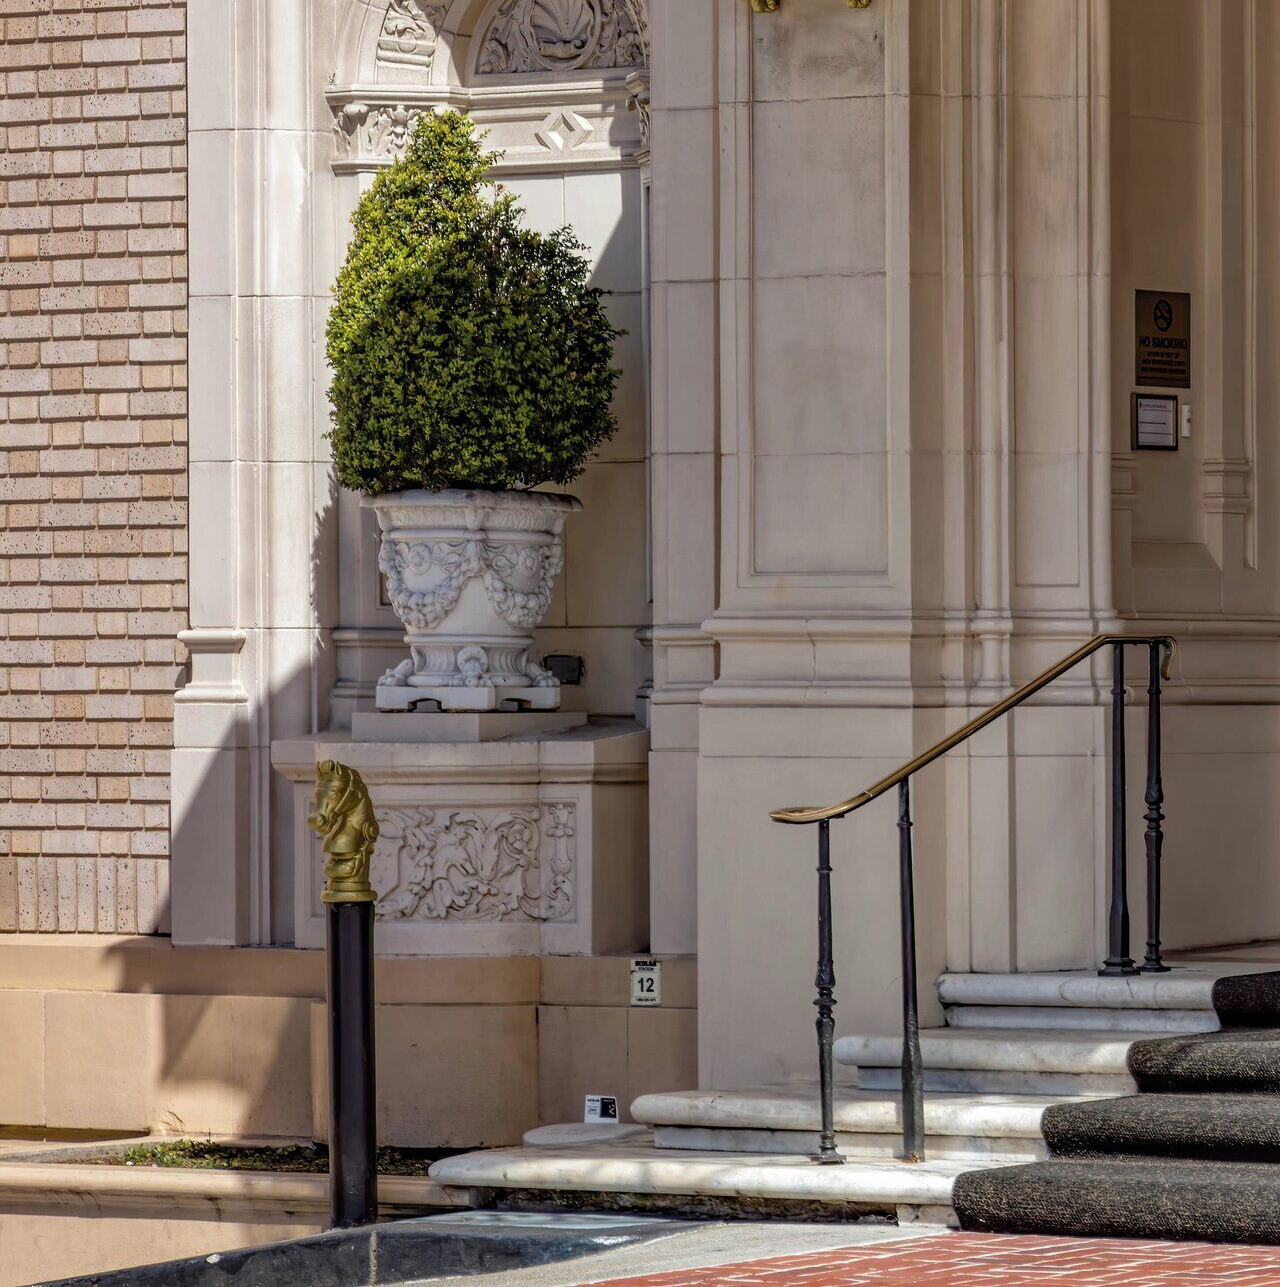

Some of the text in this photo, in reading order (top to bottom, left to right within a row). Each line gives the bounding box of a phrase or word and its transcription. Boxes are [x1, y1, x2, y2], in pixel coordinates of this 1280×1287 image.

[1138, 336, 1188, 349] NO SMOKING
[637, 977, 655, 993] 12
